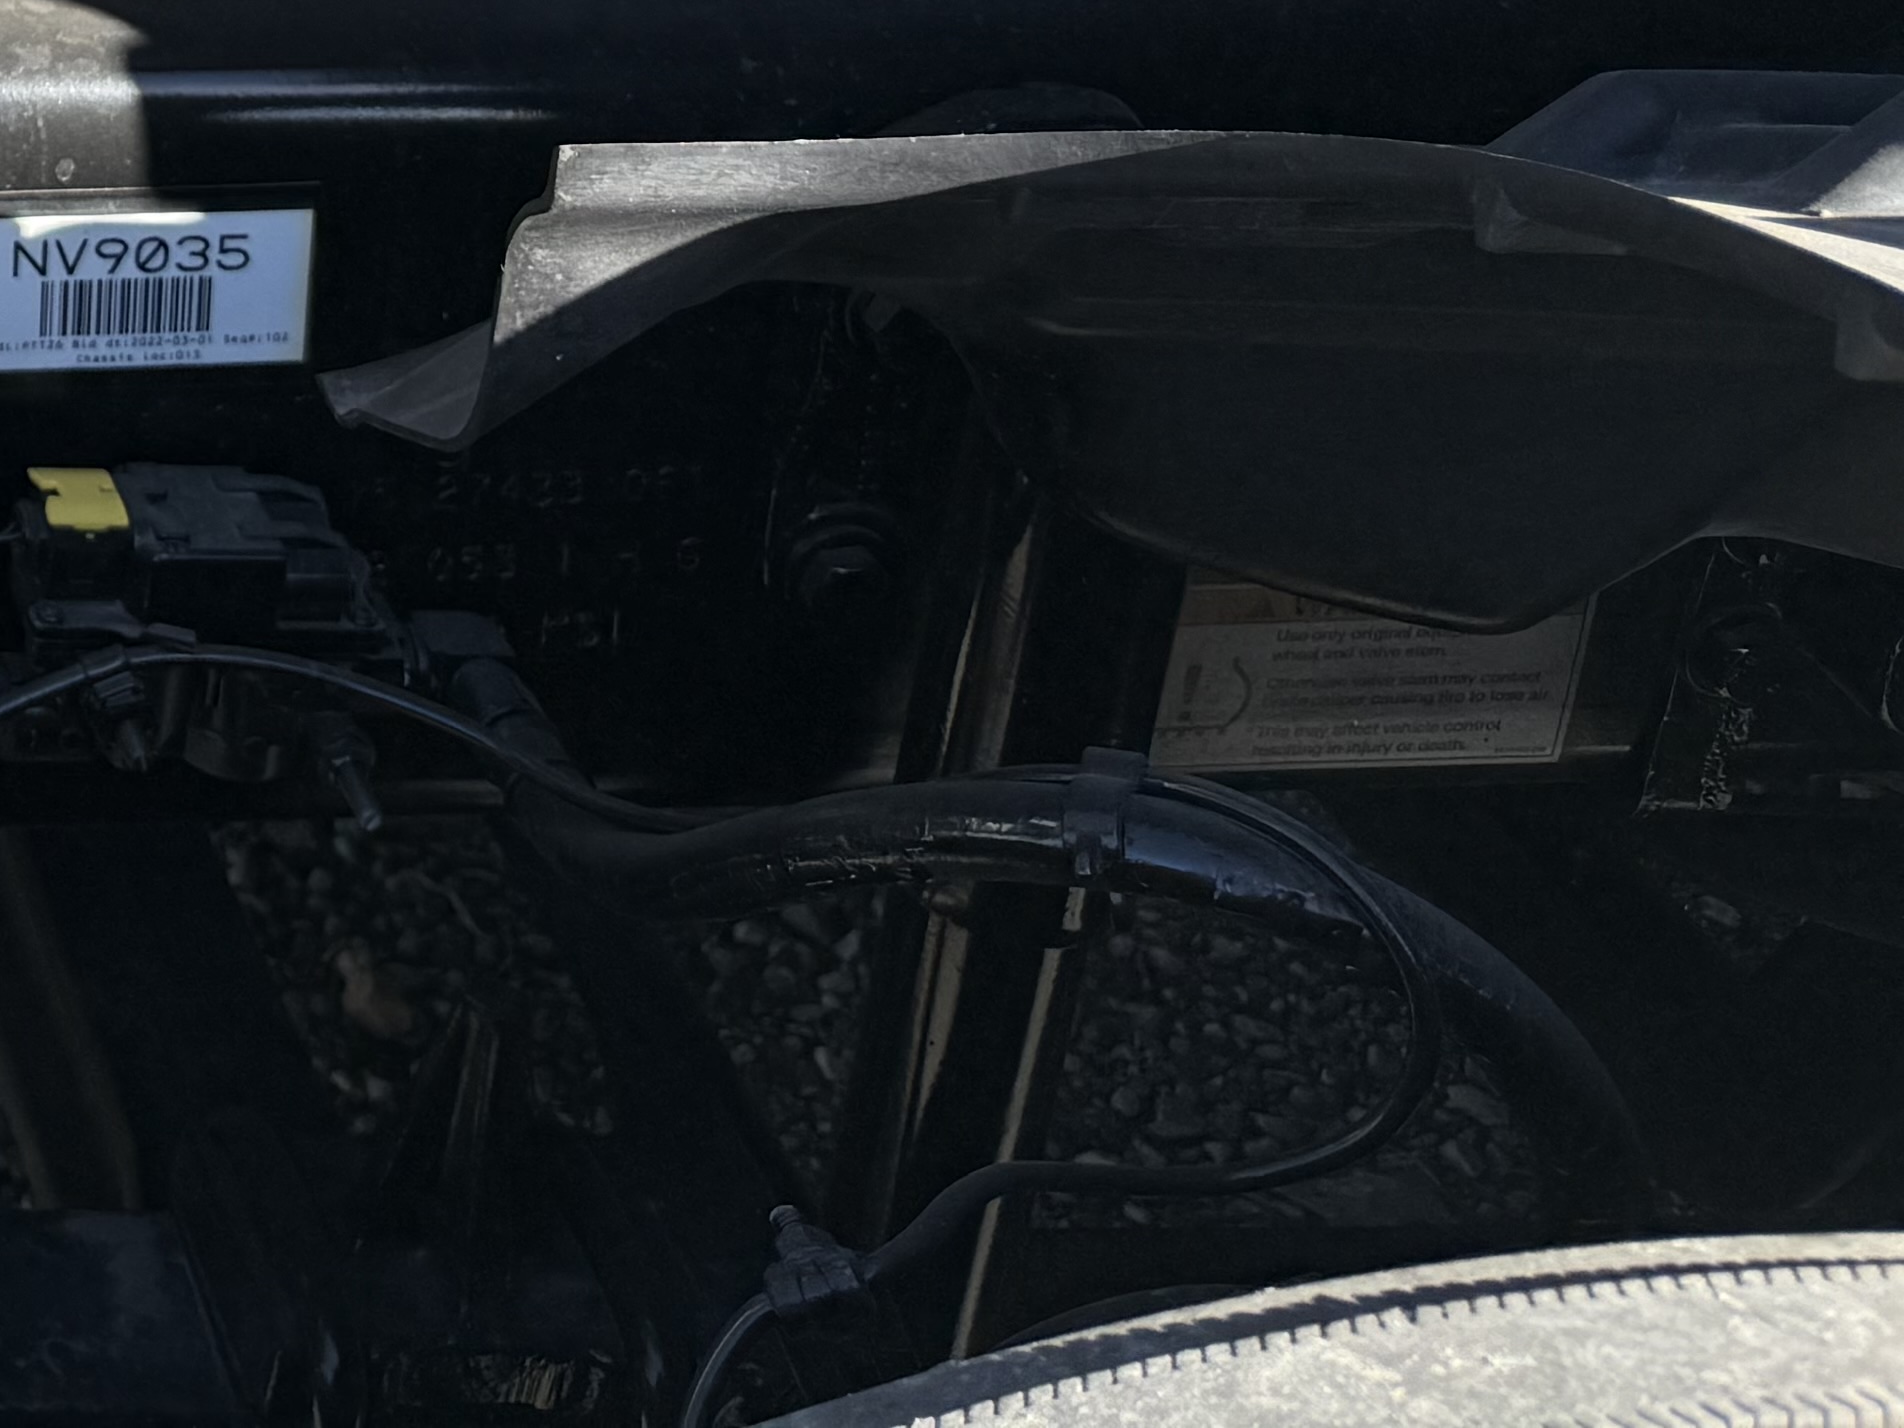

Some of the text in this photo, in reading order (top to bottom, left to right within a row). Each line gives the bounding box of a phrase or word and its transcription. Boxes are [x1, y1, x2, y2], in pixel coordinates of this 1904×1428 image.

[12, 233, 251, 278] NV9035
[1276, 627, 1309, 643] Use
[1311, 627, 1348, 644] only
[1351, 625, 1412, 644] original
[1322, 644, 1356, 660] and
[1359, 644, 1400, 659] valve
[1480, 672, 1542, 686] contact
[1369, 691, 1434, 707] causing
[1438, 689, 1466, 705] tire
[1469, 689, 1486, 705] to
[1293, 725, 1328, 740] may
[1382, 721, 1440, 735] vehicle
[1443, 720, 1502, 734] control
[1345, 740, 1390, 758] injury
[1394, 741, 1413, 754] or
